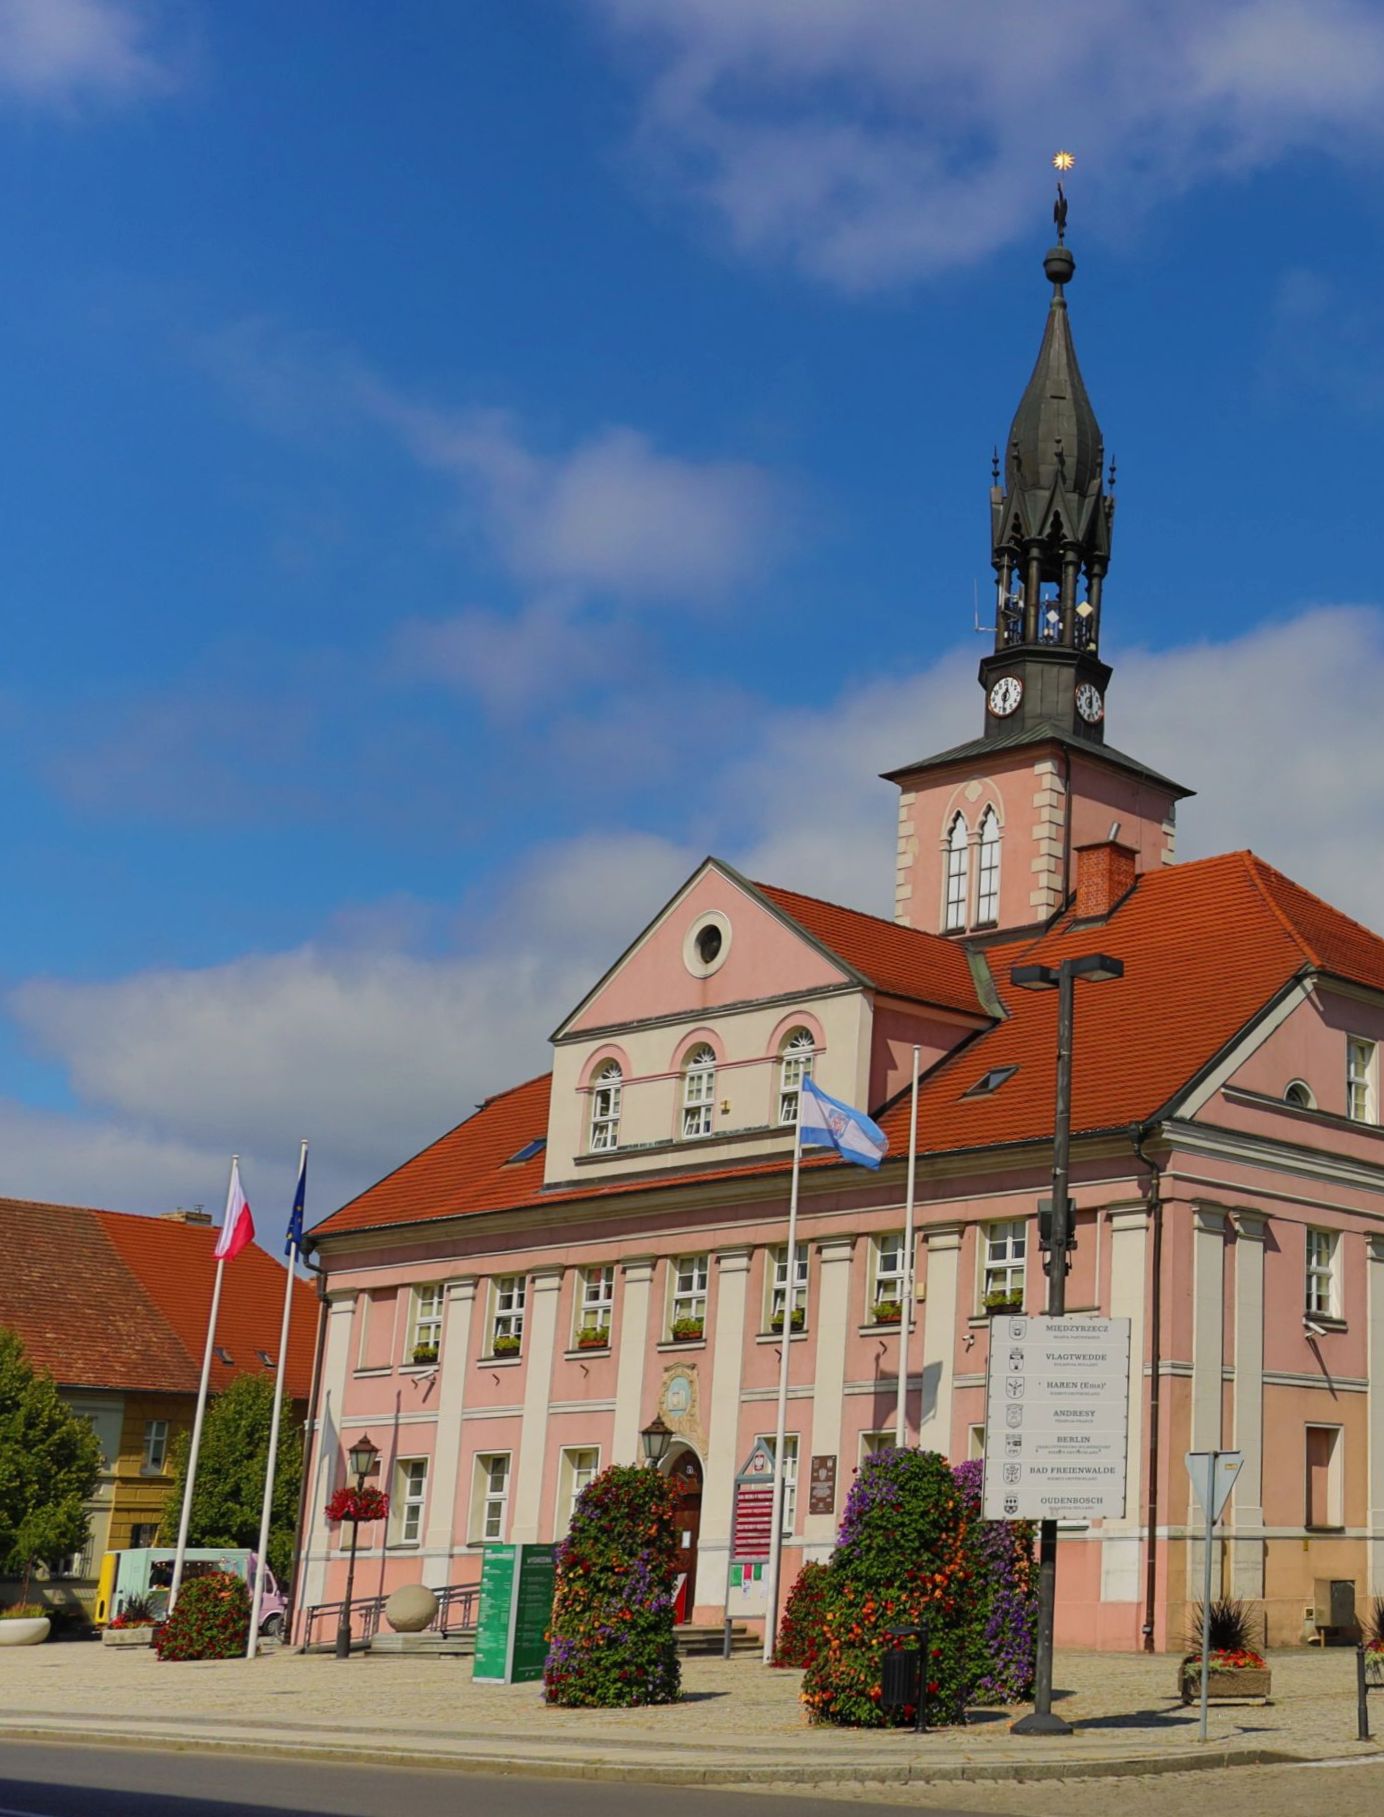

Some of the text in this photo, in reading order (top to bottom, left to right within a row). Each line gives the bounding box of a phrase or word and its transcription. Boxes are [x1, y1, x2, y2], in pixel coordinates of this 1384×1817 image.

[1045, 1353, 1108, 1361] VLAGTWEDDE
[1046, 1381, 1078, 1389] HAREN
[1052, 1409, 1096, 1418] ANDRESY
[1056, 1435, 1091, 1443] BERLIN
[1029, 1466, 1116, 1475] BAD FREIENWALDE
[1040, 1496, 1104, 1505] OUDENBOSCH
